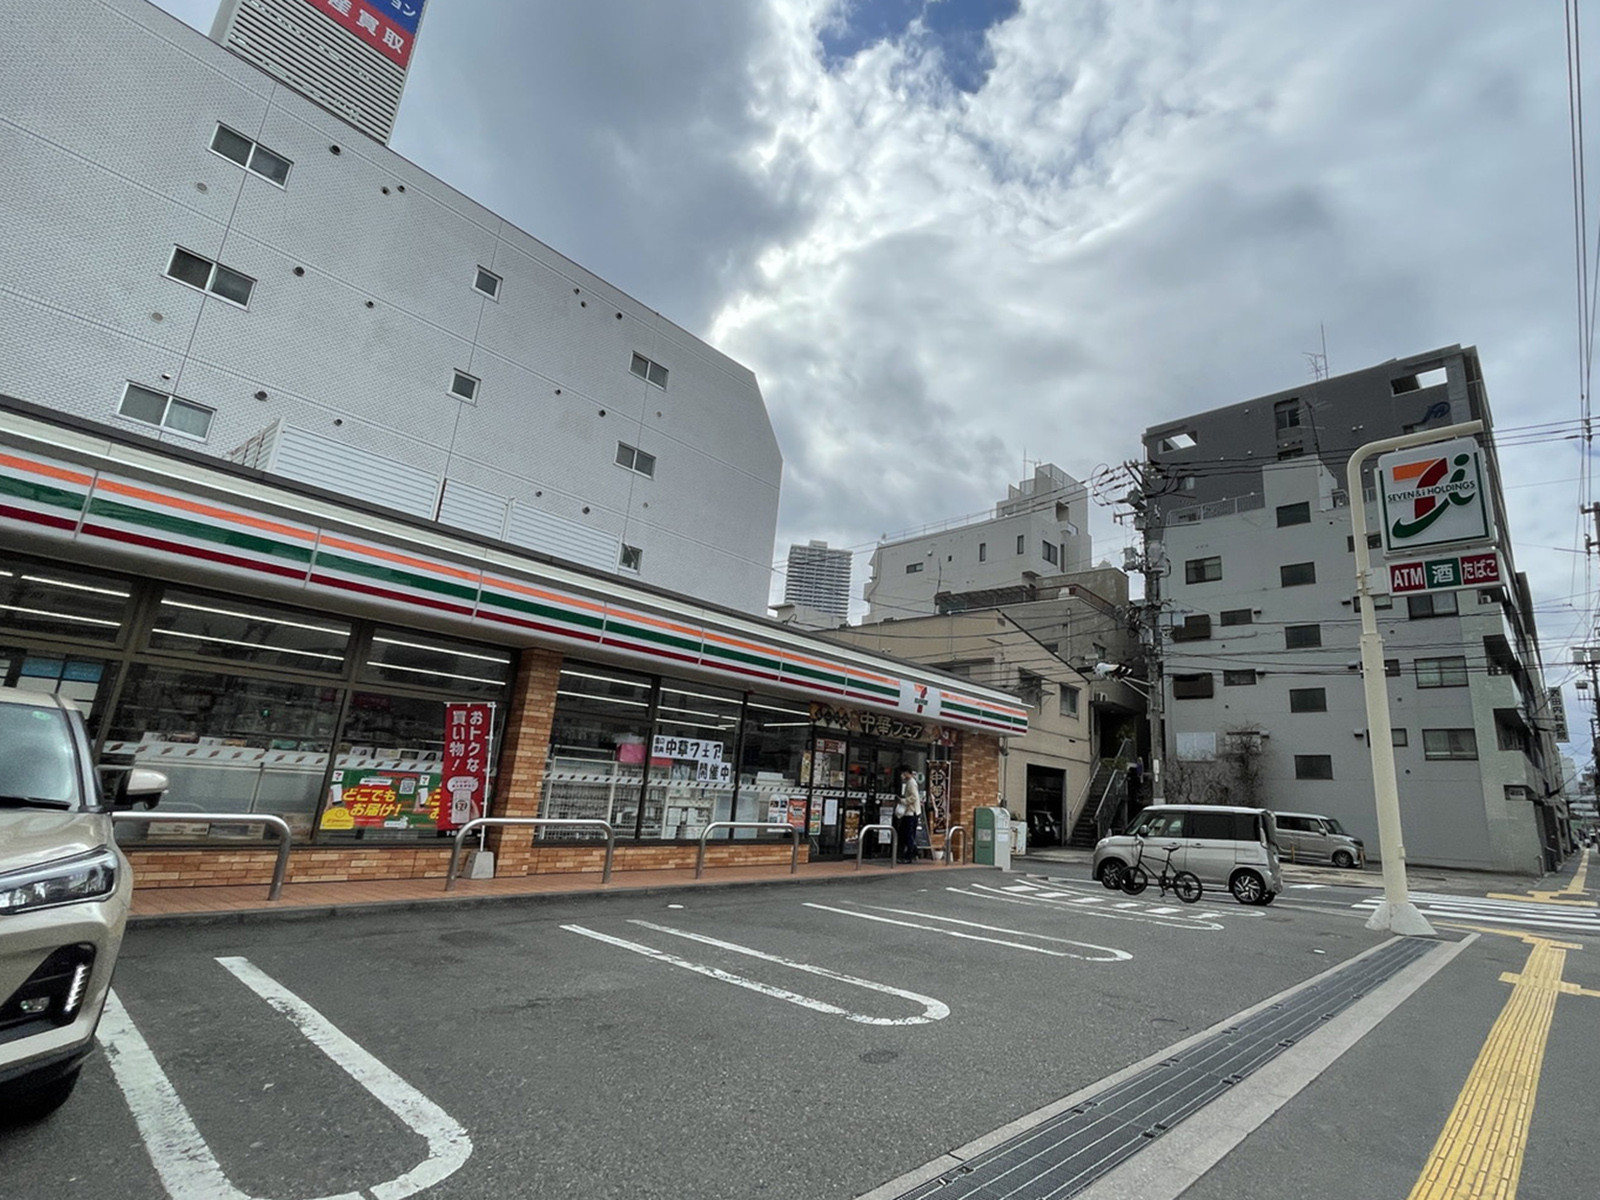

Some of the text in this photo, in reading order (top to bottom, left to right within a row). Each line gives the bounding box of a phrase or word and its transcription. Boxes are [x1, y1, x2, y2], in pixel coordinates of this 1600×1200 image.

[1427, 480, 1476, 494] HOLDINGS
[1393, 566, 1424, 588] ATM
[1432, 563, 1454, 584] 酒
[1462, 559, 1498, 580] たばこ
[860, 712, 923, 738] 中華フェア
[449, 711, 466, 771] 買い物！
[467, 711, 483, 772] おトクな
[698, 762, 730, 781] 開催中
[343, 788, 396, 802] どこでも
[350, 803, 402, 817] お届け！
